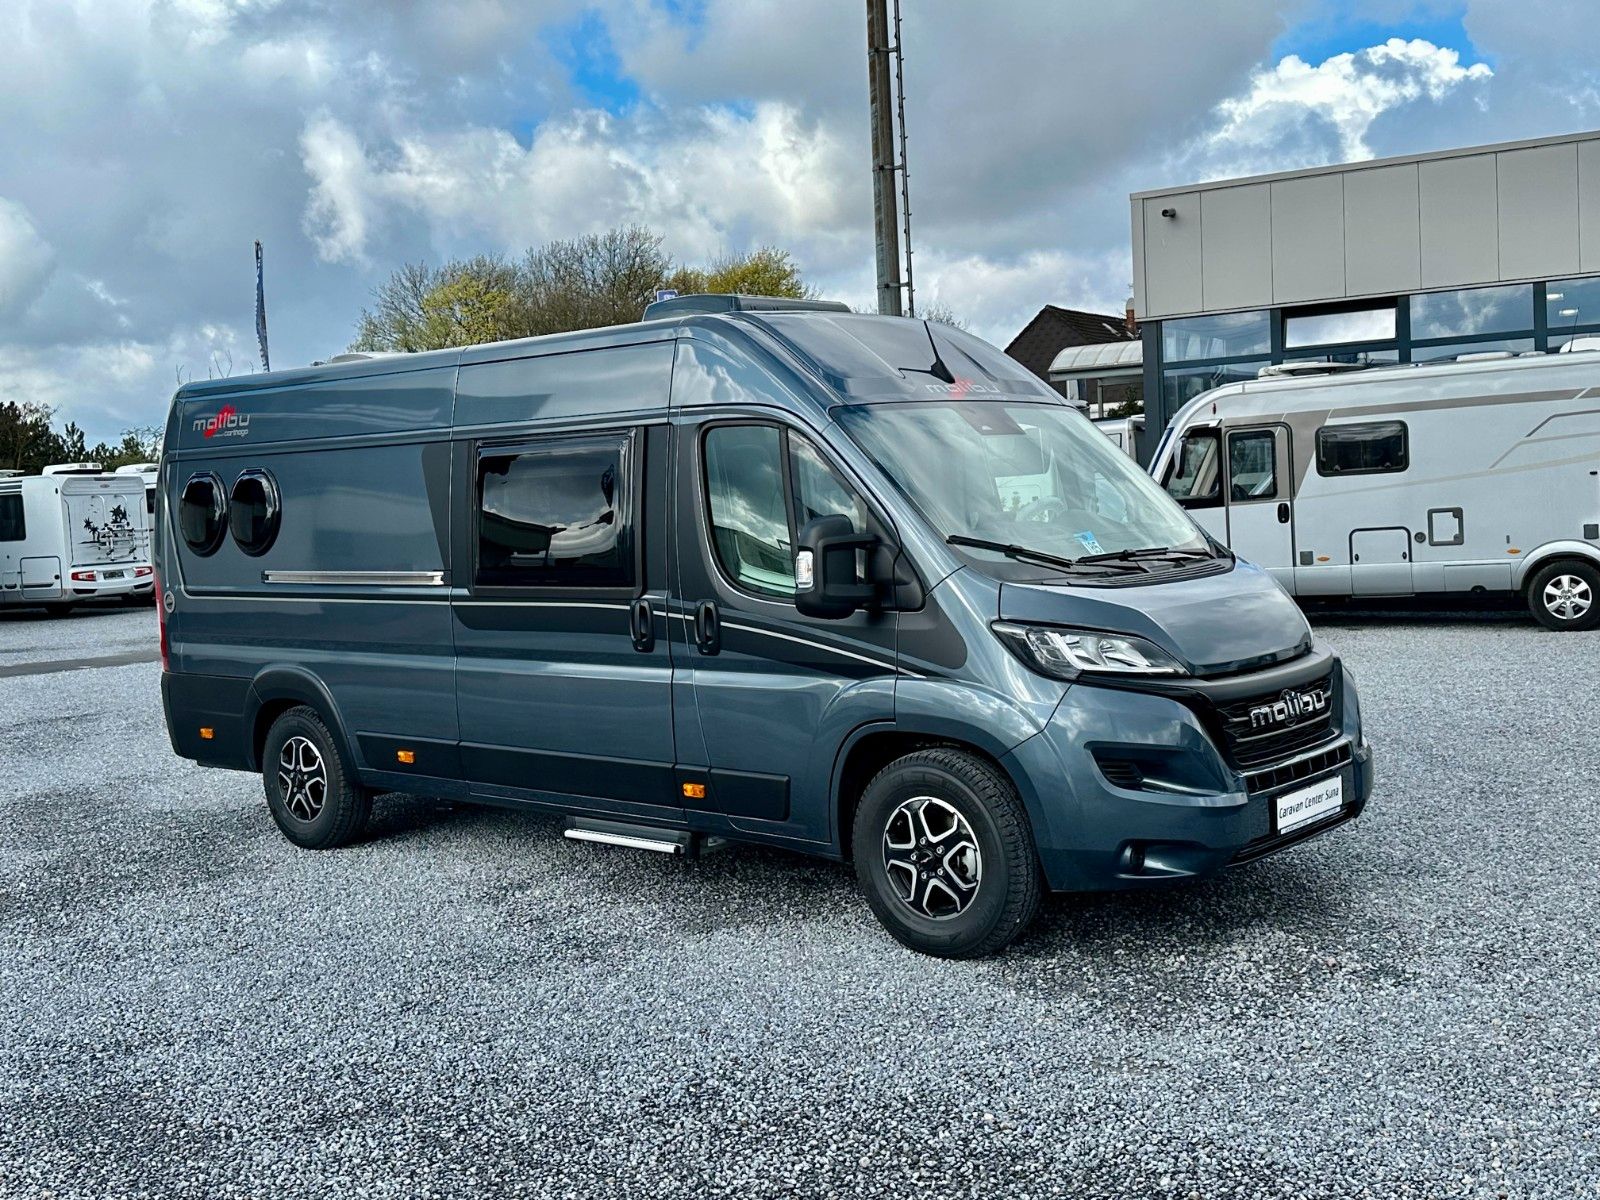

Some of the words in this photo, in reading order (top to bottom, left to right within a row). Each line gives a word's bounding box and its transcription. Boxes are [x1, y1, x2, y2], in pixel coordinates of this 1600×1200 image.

[925, 381, 1000, 393] malibu
[192, 412, 250, 431] malibu
[1250, 690, 1325, 728] malibu
[1279, 801, 1303, 819] Caravan
[1304, 793, 1324, 809] Center
